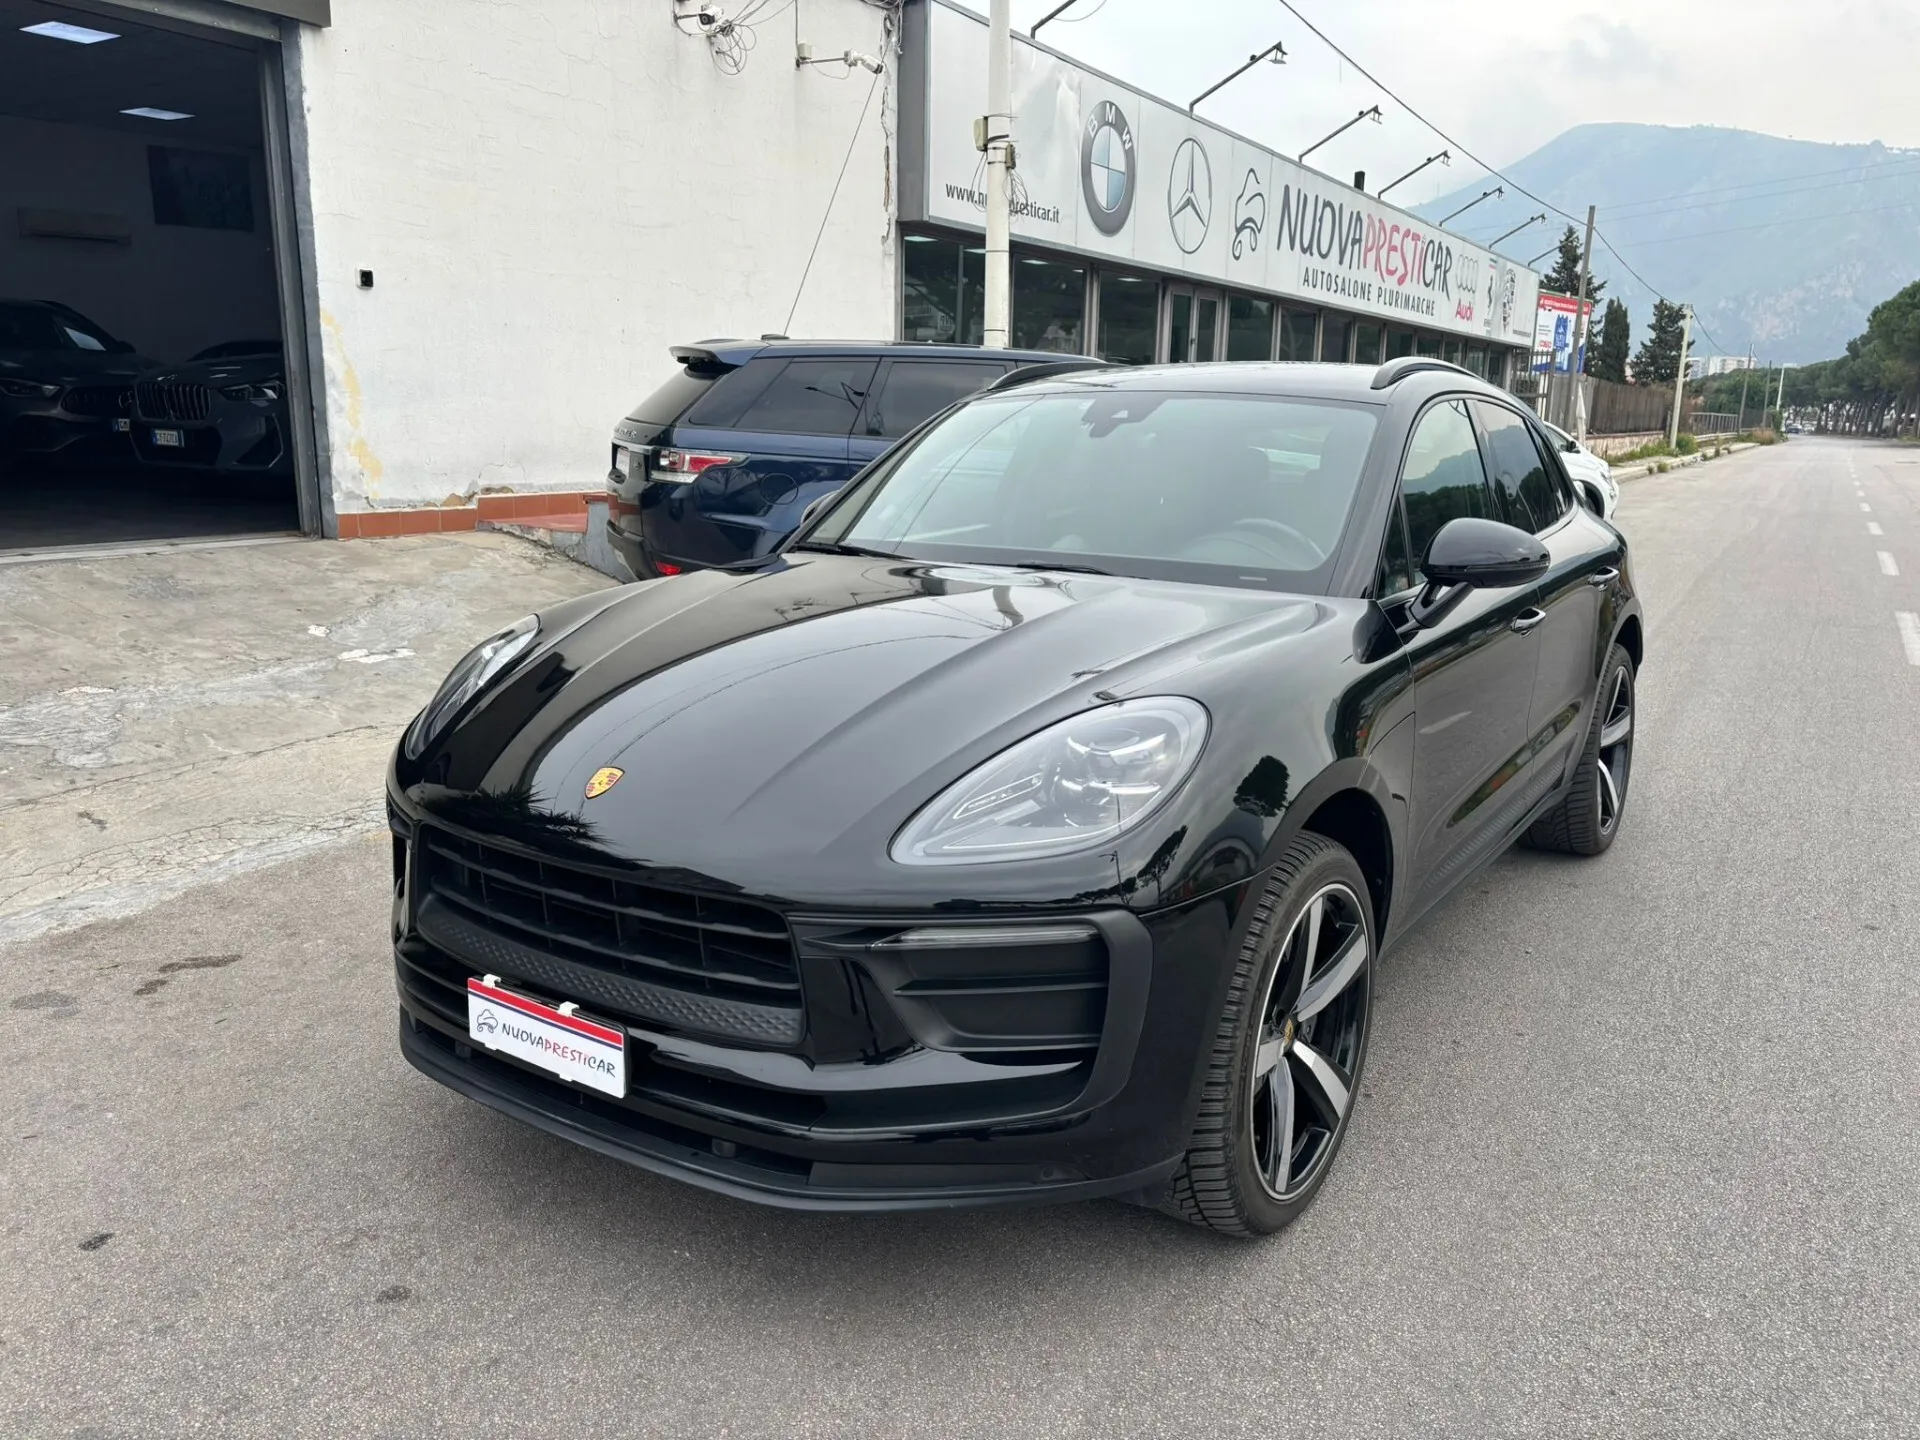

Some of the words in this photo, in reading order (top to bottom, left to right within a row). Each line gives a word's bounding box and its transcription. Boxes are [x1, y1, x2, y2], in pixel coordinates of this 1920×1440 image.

[1088, 102, 1132, 150] BMW
[1303, 267, 1372, 302] AUTOSALONE
[1377, 285, 1435, 317] PLURIMARCHE
[1455, 298, 1474, 321] Audi
